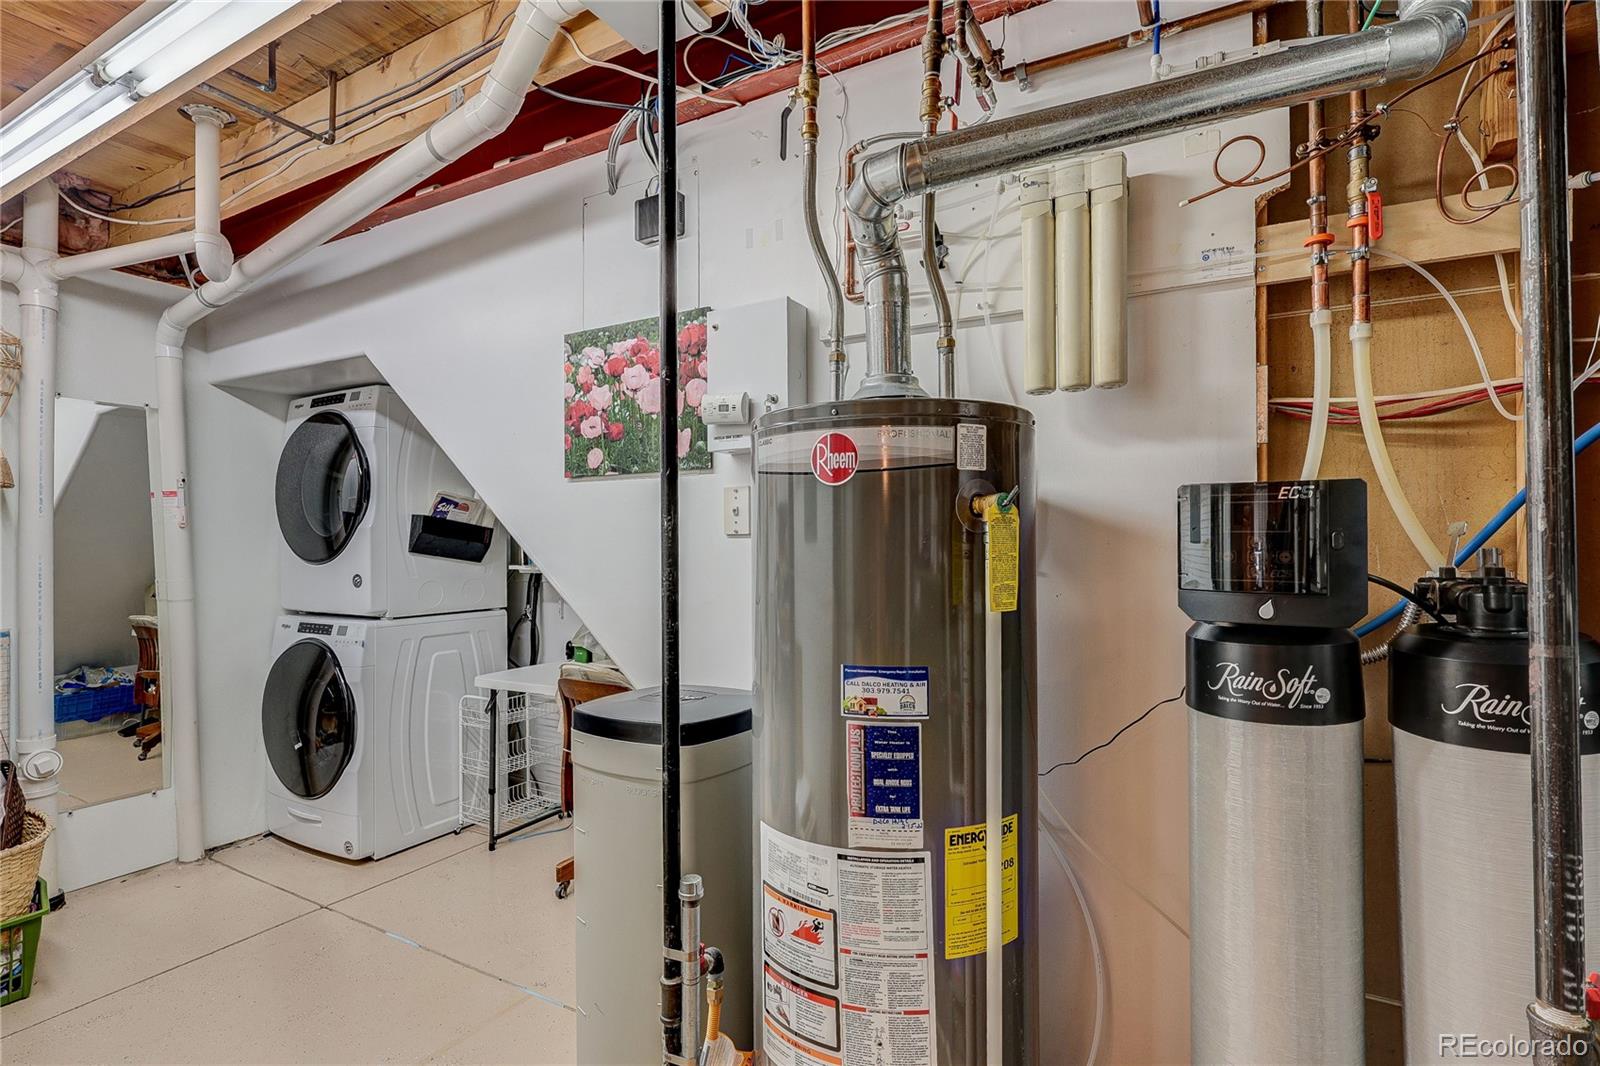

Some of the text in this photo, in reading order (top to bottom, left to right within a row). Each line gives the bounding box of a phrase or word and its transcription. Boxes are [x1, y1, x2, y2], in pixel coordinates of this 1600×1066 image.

[816, 432, 856, 478] Rheem
[1458, 720, 1476, 729] Taking
[1487, 724, 1506, 733] Worry
